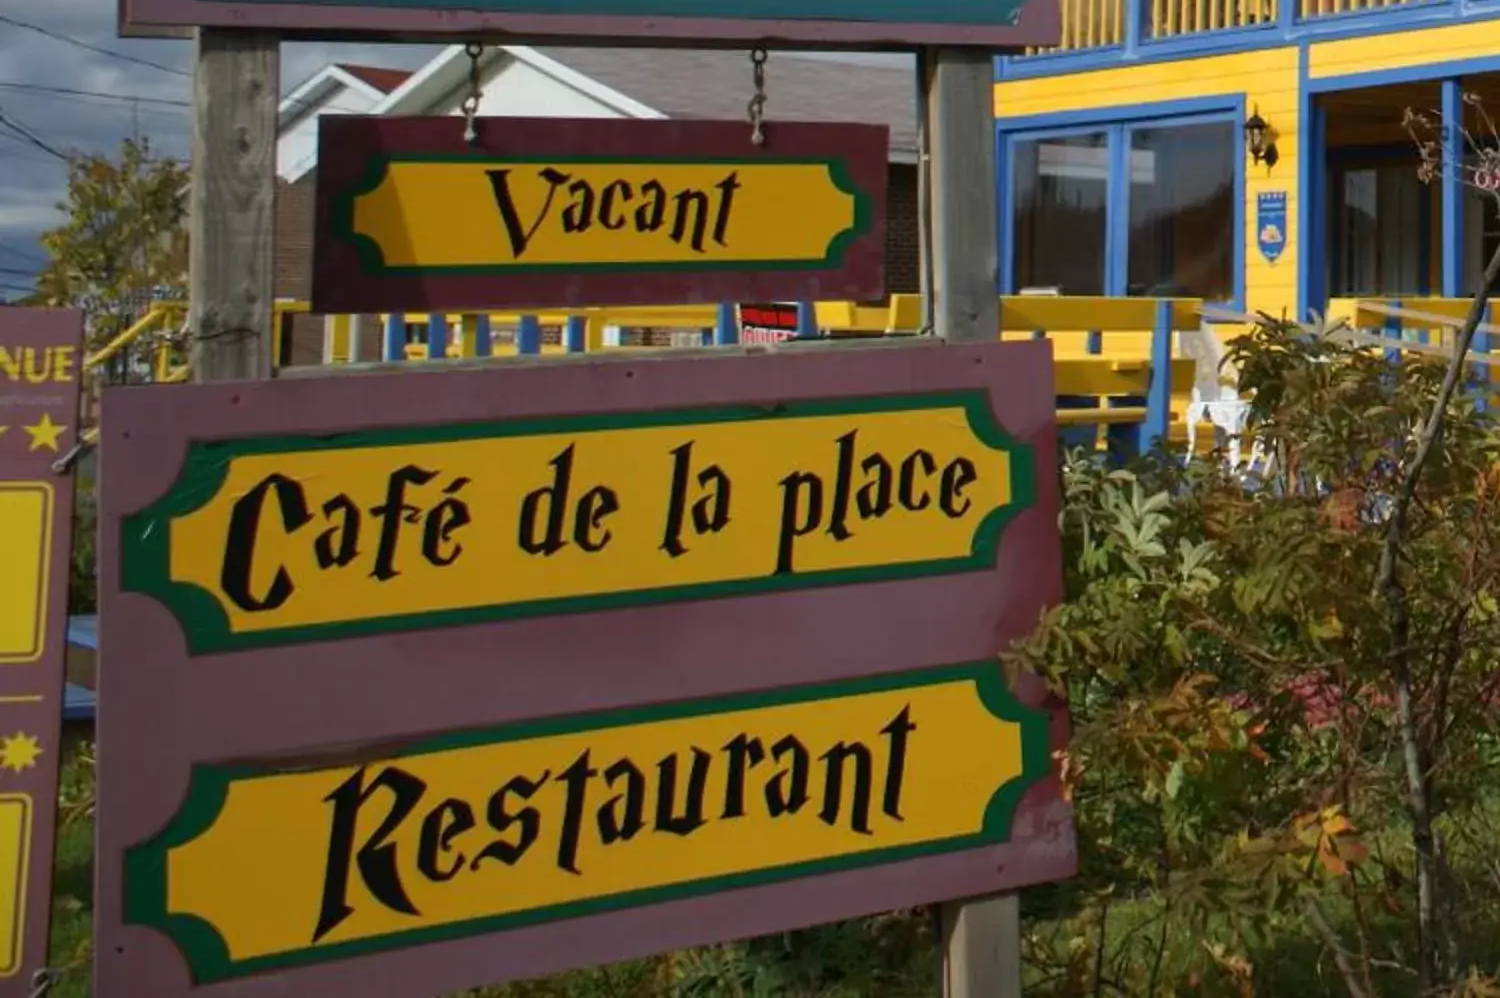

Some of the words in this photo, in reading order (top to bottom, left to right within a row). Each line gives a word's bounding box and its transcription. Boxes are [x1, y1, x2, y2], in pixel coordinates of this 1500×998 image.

[485, 167, 741, 259] Vacant
[220, 463, 472, 612] Café
[518, 443, 619, 557] de
[659, 440, 731, 558] la
[772, 429, 978, 576] place
[311, 703, 917, 944] Restaurant
